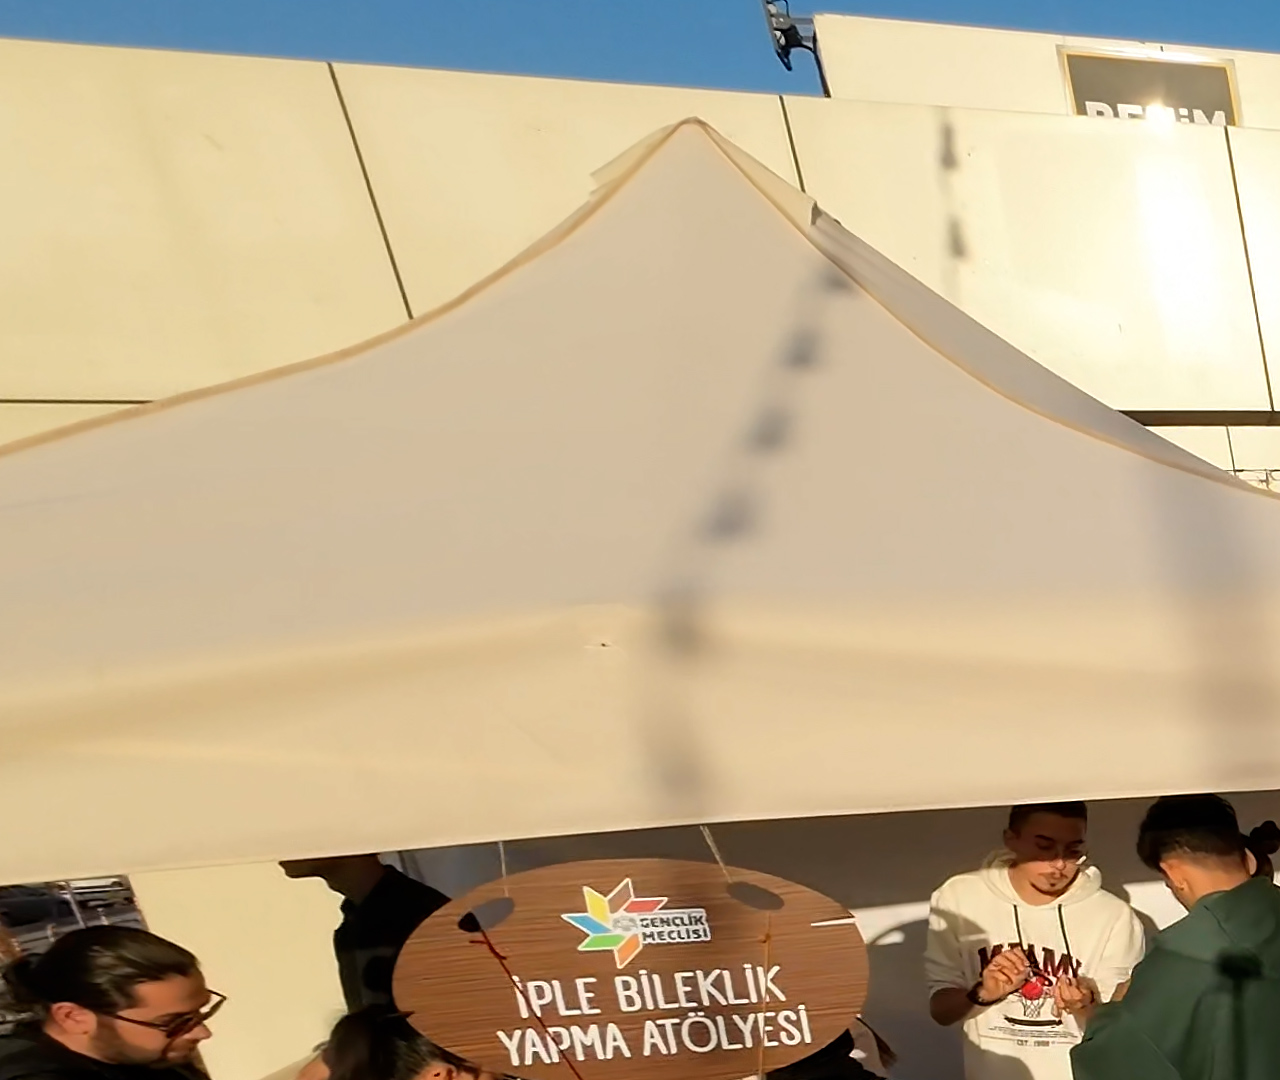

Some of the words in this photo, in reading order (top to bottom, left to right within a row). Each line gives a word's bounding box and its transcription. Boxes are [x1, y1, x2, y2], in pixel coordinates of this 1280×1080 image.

[639, 914, 705, 928] GENÇLİK
[641, 928, 710, 942] MECLİSİ
[511, 975, 602, 1019] İPLE
[613, 963, 787, 1013] BİLEKLİK
[496, 1021, 632, 1066] YAPMA
[643, 1004, 814, 1057] ATÖLYESİ
